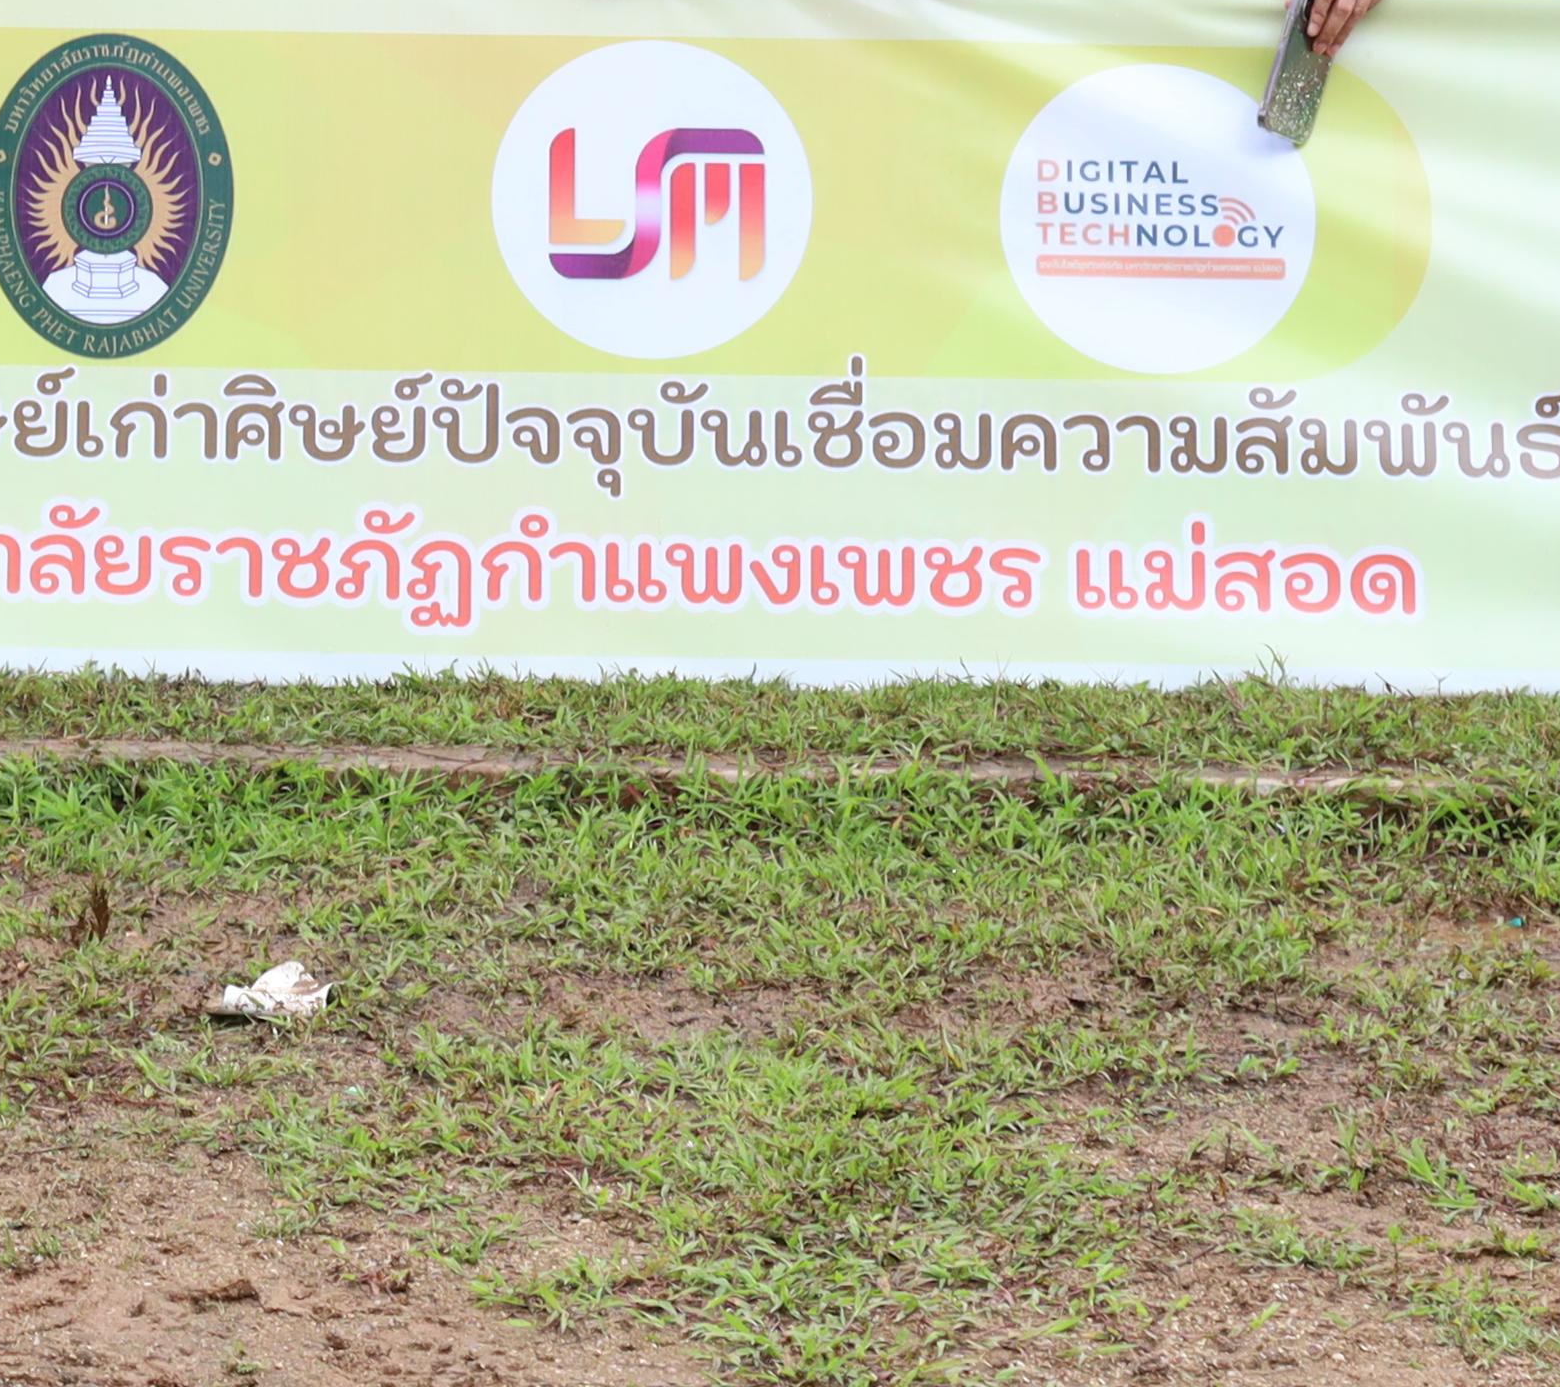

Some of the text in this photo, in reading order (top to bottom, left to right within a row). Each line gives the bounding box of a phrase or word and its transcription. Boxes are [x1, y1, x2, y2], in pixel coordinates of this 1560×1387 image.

[1037, 159, 1188, 184] DIGITAL
[1037, 191, 1218, 216] BUSINESS
[32, 307, 79, 345] PHET
[83, 308, 178, 356] RAJABHAT
[177, 198, 226, 308] UNIVERSITY
[1077, 523, 1419, 616] แม่สอด
